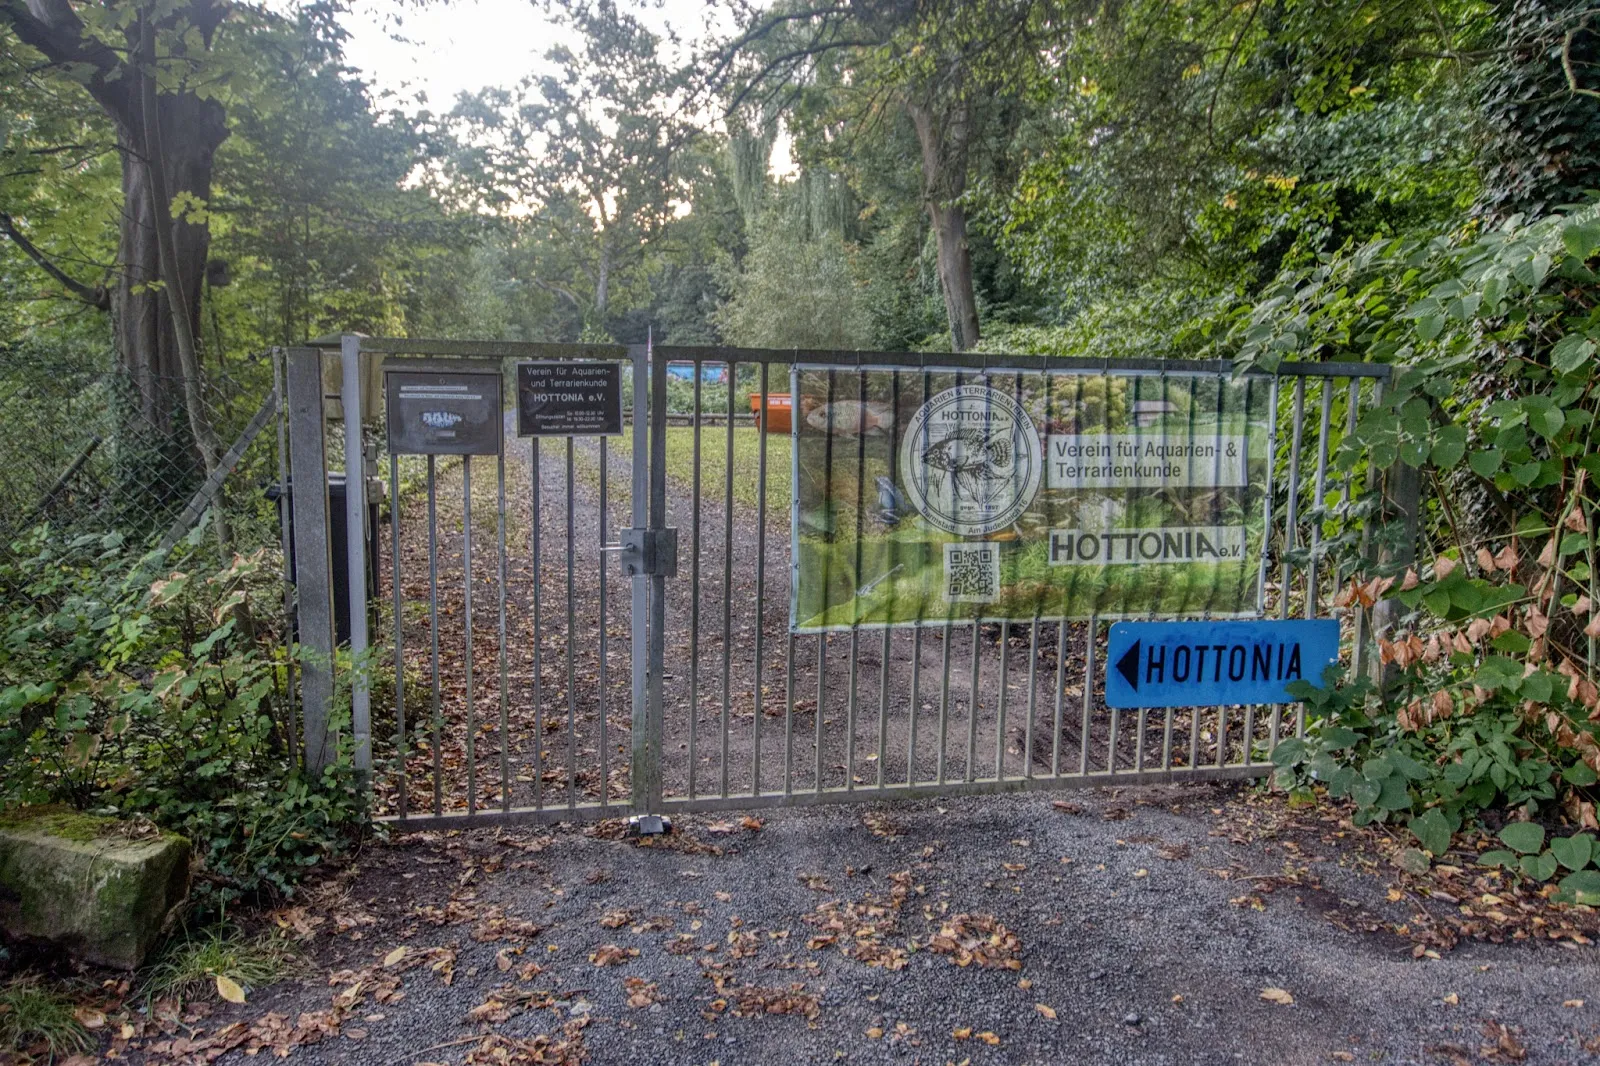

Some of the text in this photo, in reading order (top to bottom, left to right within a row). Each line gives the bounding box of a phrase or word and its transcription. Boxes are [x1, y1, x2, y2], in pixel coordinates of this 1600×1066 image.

[527, 367, 611, 377] Verein für Aquarien-
[531, 378, 608, 387] und Terrarienkunde
[534, 393, 606, 402] HOTTONIA e.V.
[915, 386, 1033, 431] AQUARIEN & TERRARIENVEREIN
[941, 410, 1000, 422] HOTTONIA
[1055, 441, 1237, 460] Verein für Aquarien- &
[1055, 462, 1181, 478] Terrarienkunde
[922, 507, 956, 532] Darmstadt
[968, 526, 981, 535] Am
[1019, 499, 1028, 510] 16
[1051, 531, 1241, 562] HOTTONIA e.V.
[1145, 642, 1302, 684] HOTTONIA
